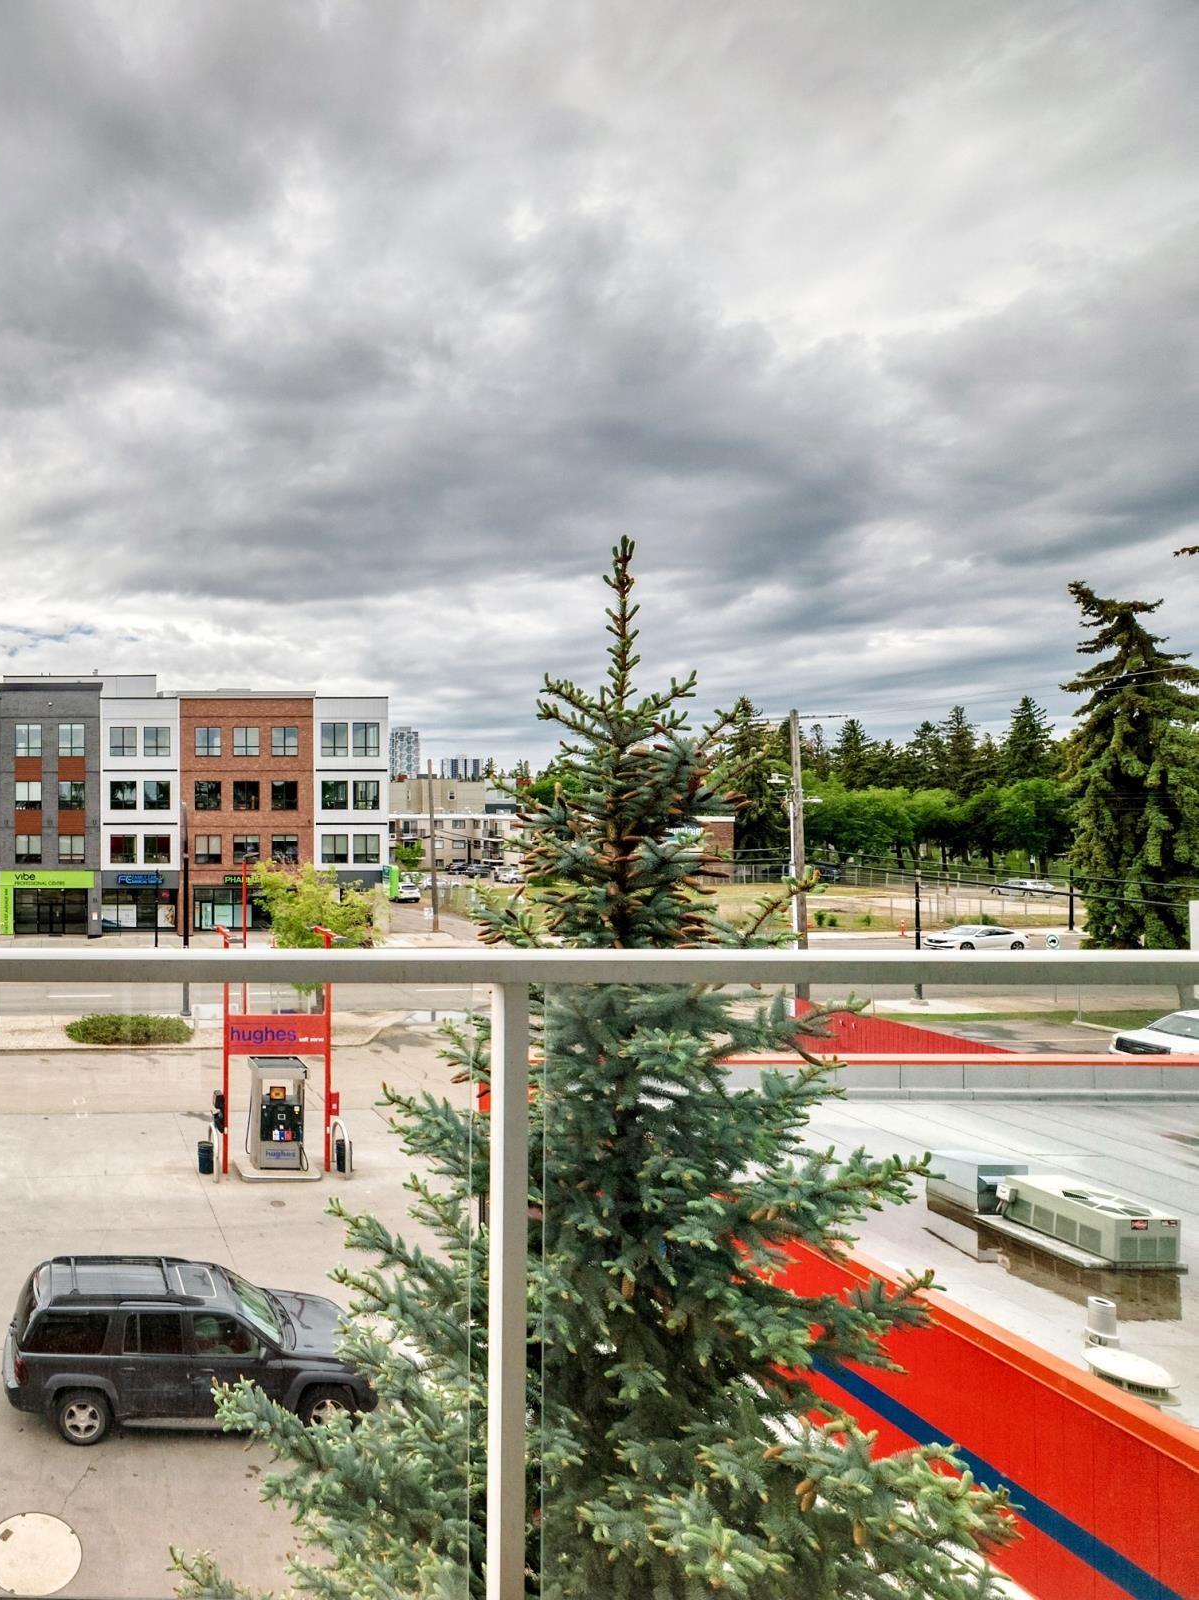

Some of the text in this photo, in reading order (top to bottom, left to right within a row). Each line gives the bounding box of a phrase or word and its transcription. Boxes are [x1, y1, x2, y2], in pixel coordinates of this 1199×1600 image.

[14, 872, 36, 881] vibe
[230, 1026, 297, 1044] hughes
[303, 1070, 308, 1079] 1
